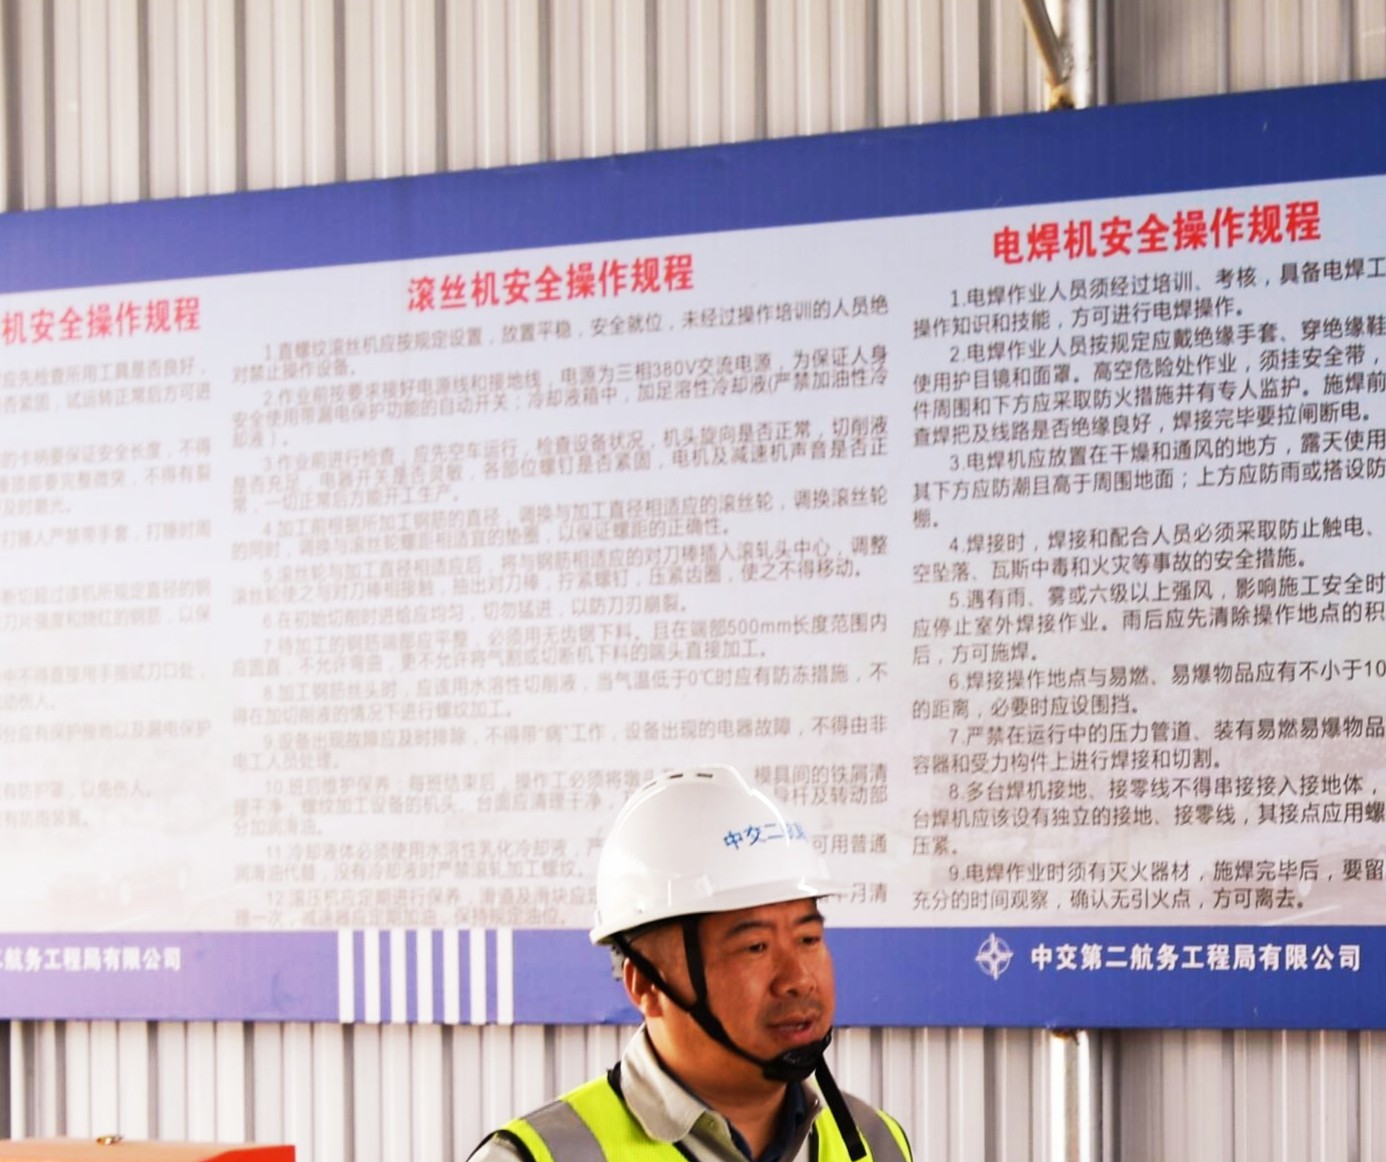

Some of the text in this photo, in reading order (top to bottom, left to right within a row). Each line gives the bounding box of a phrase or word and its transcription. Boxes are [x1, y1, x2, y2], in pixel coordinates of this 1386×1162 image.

[994, 199, 1320, 266] 电焊机安全操作规程
[407, 253, 693, 313] 滚丝机安全操作规程
[3, 295, 200, 346] 机安全操作规程
[1031, 942, 1361, 971] 中交第二航务工程局有限公司
